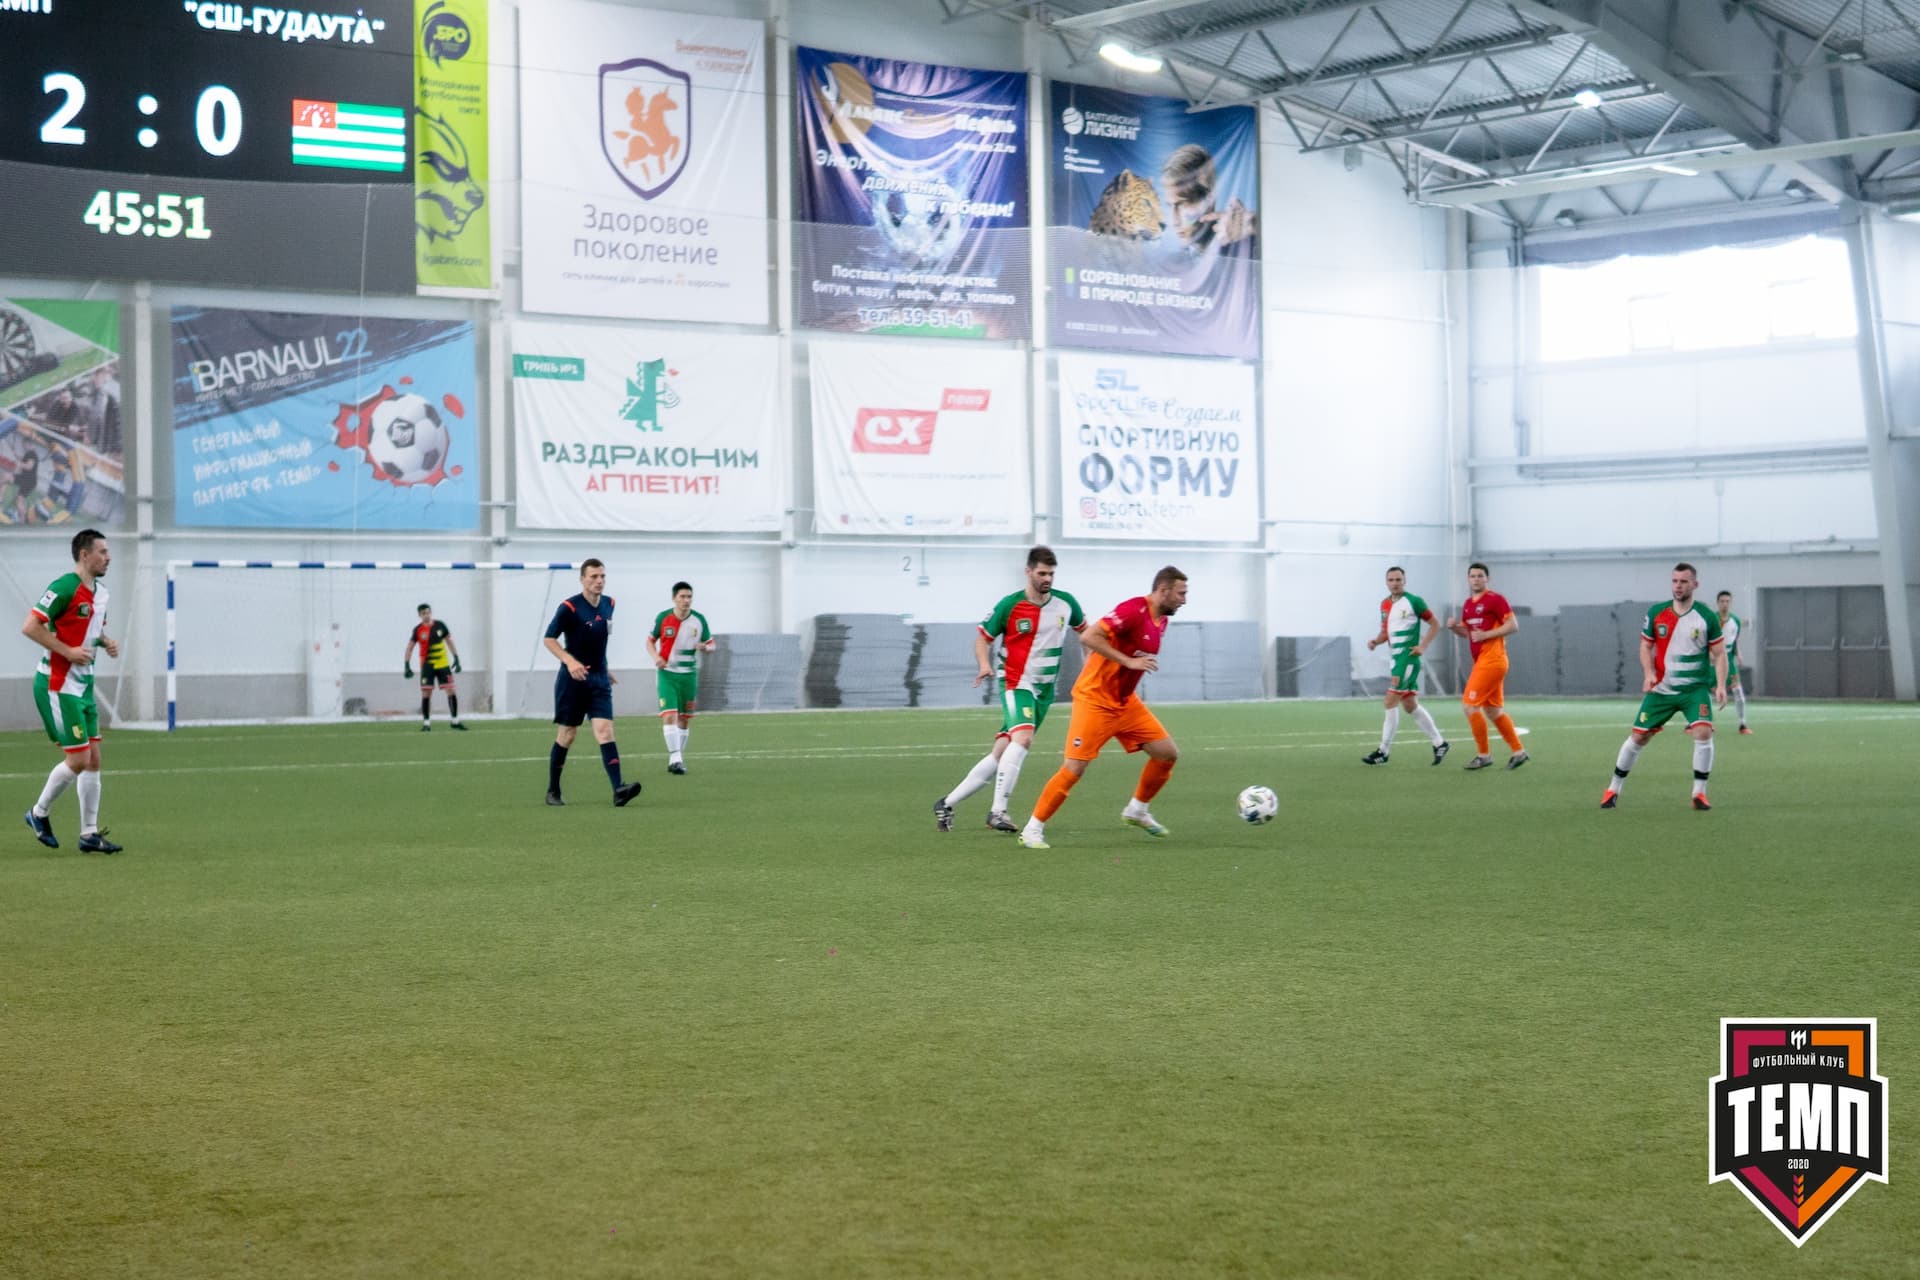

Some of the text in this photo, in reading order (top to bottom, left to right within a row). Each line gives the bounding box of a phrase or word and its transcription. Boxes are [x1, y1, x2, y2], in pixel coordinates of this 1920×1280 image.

[40, 72, 243, 156] 2 : 0
[1084, 121, 1141, 140] ЛИЗИНГ
[83, 190, 212, 239] 45:51
[583, 203, 709, 235] Здоровое
[573, 238, 718, 266] поколение
[1080, 269, 1182, 290] СОРЕВНОВАНИЕ
[1080, 286, 1213, 310] В ПРИРОДЕ БИЗНЕСА
[902, 307, 974, 329] 39-51-41
[1078, 424, 1240, 453] СПОРТИВНУЮ
[541, 441, 759, 469] РАЗДРАКОНИМ
[585, 473, 720, 495] АППЕТИТ!
[1079, 452, 1240, 498] ФОРМУ
[903, 556, 912, 571] 2
